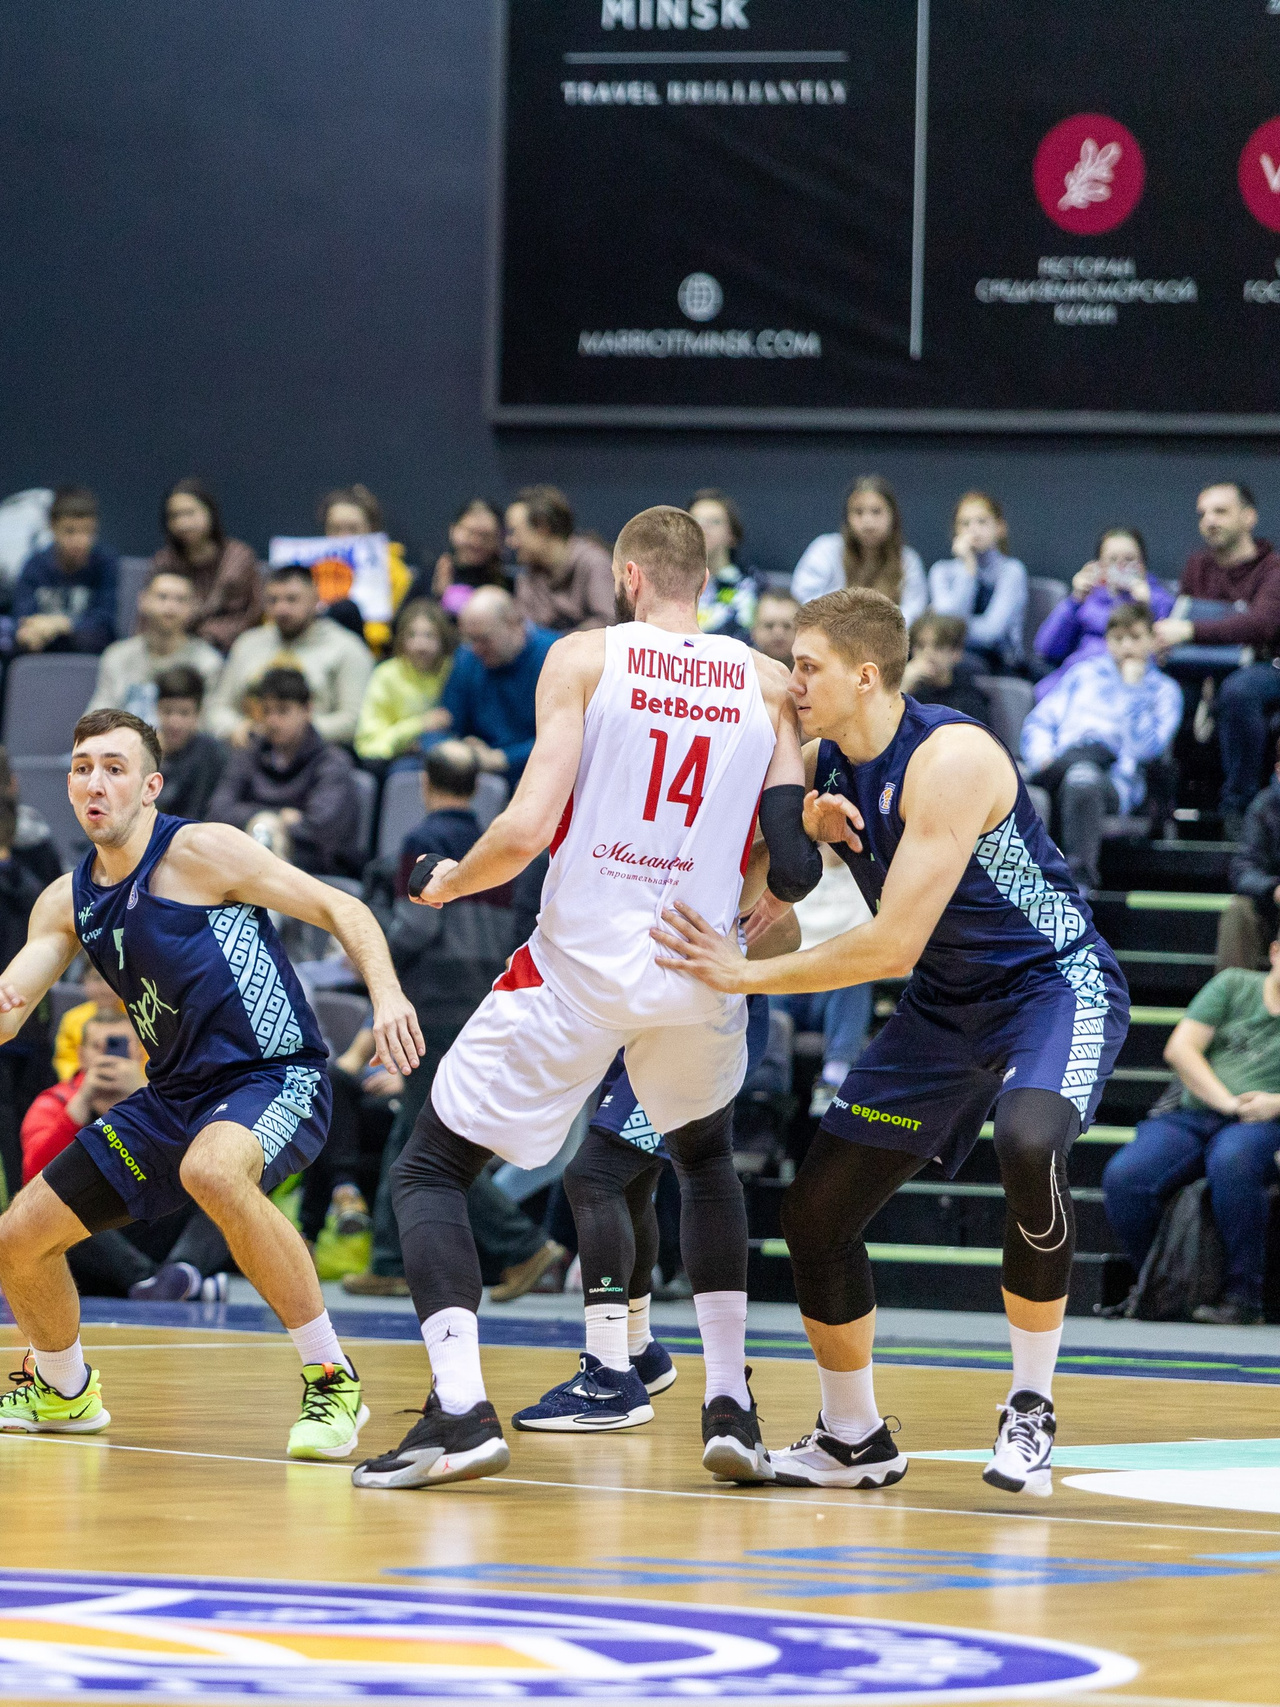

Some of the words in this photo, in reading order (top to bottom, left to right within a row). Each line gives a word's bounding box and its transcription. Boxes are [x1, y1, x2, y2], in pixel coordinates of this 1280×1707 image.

[601, 0, 750, 30] MINSK
[561, 79, 663, 106] TRAVEL
[627, 646, 746, 690] MINCHENKO
[630, 687, 741, 724] BetBoom
[642, 728, 711, 828] 14
[851, 1103, 923, 1132] евроопт
[102, 1124, 148, 1181] евроопт
